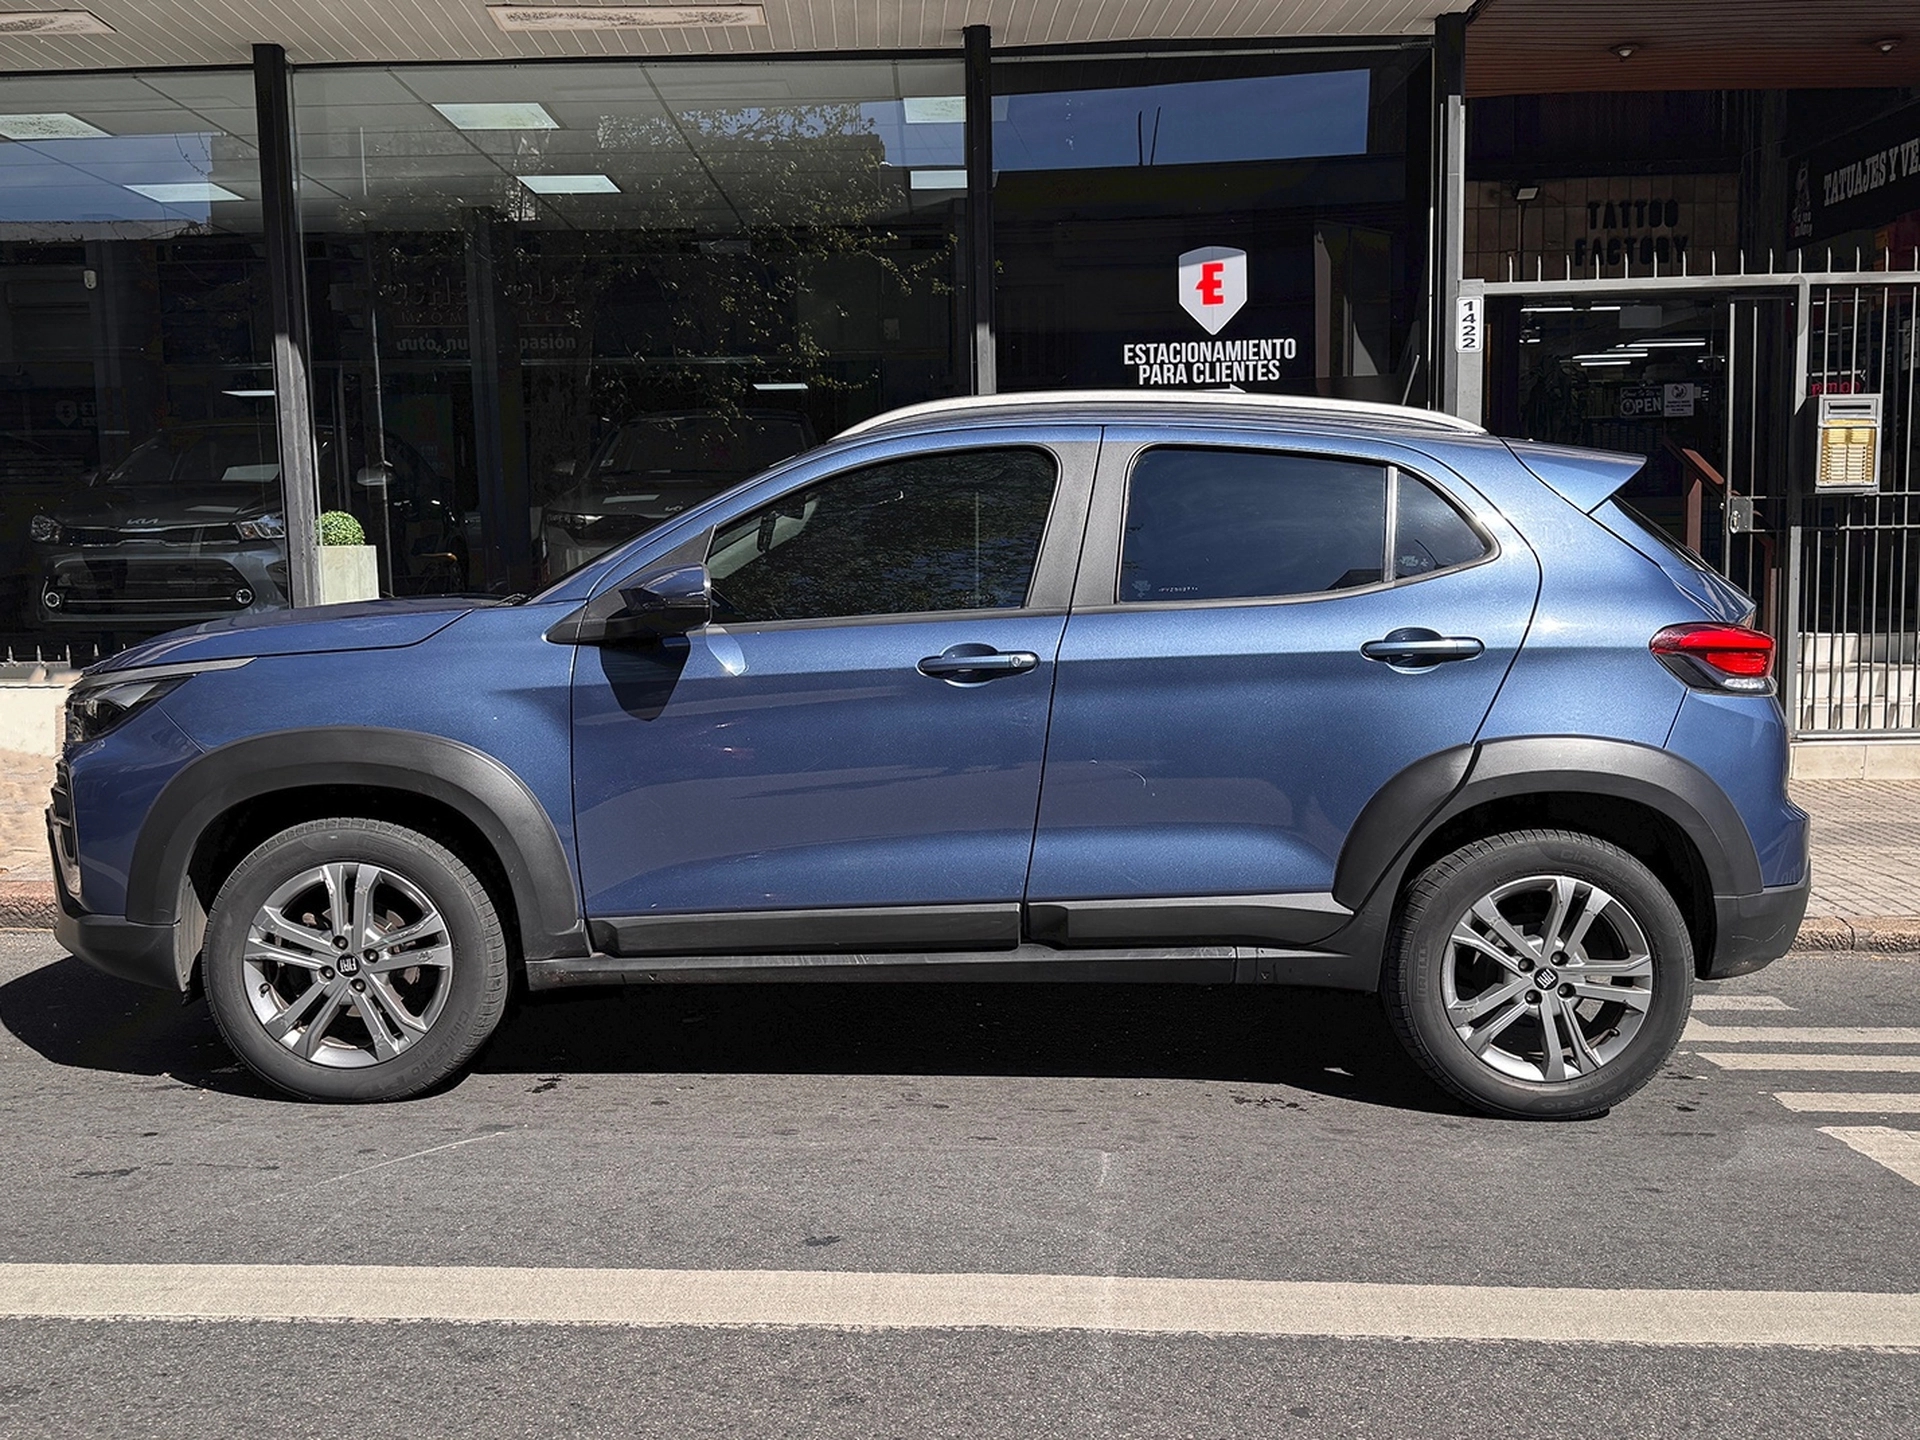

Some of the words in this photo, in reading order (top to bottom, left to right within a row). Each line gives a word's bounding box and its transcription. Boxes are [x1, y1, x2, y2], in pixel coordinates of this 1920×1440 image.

[1823, 150, 1887, 207] TATUAJES
[1888, 146, 1899, 183] Y
[1899, 137, 1920, 179] VE
[1587, 198, 1679, 229] TATTOO
[1574, 235, 1689, 266] FACTORY
[1461, 300, 1477, 349] 1422
[519, 332, 577, 354] pasión
[1123, 338, 1297, 365] ESTACIONAMIENTO
[1138, 363, 1188, 386] PARA
[1192, 360, 1281, 384] CLIENTES
[1620, 396, 1662, 416] OPEN
